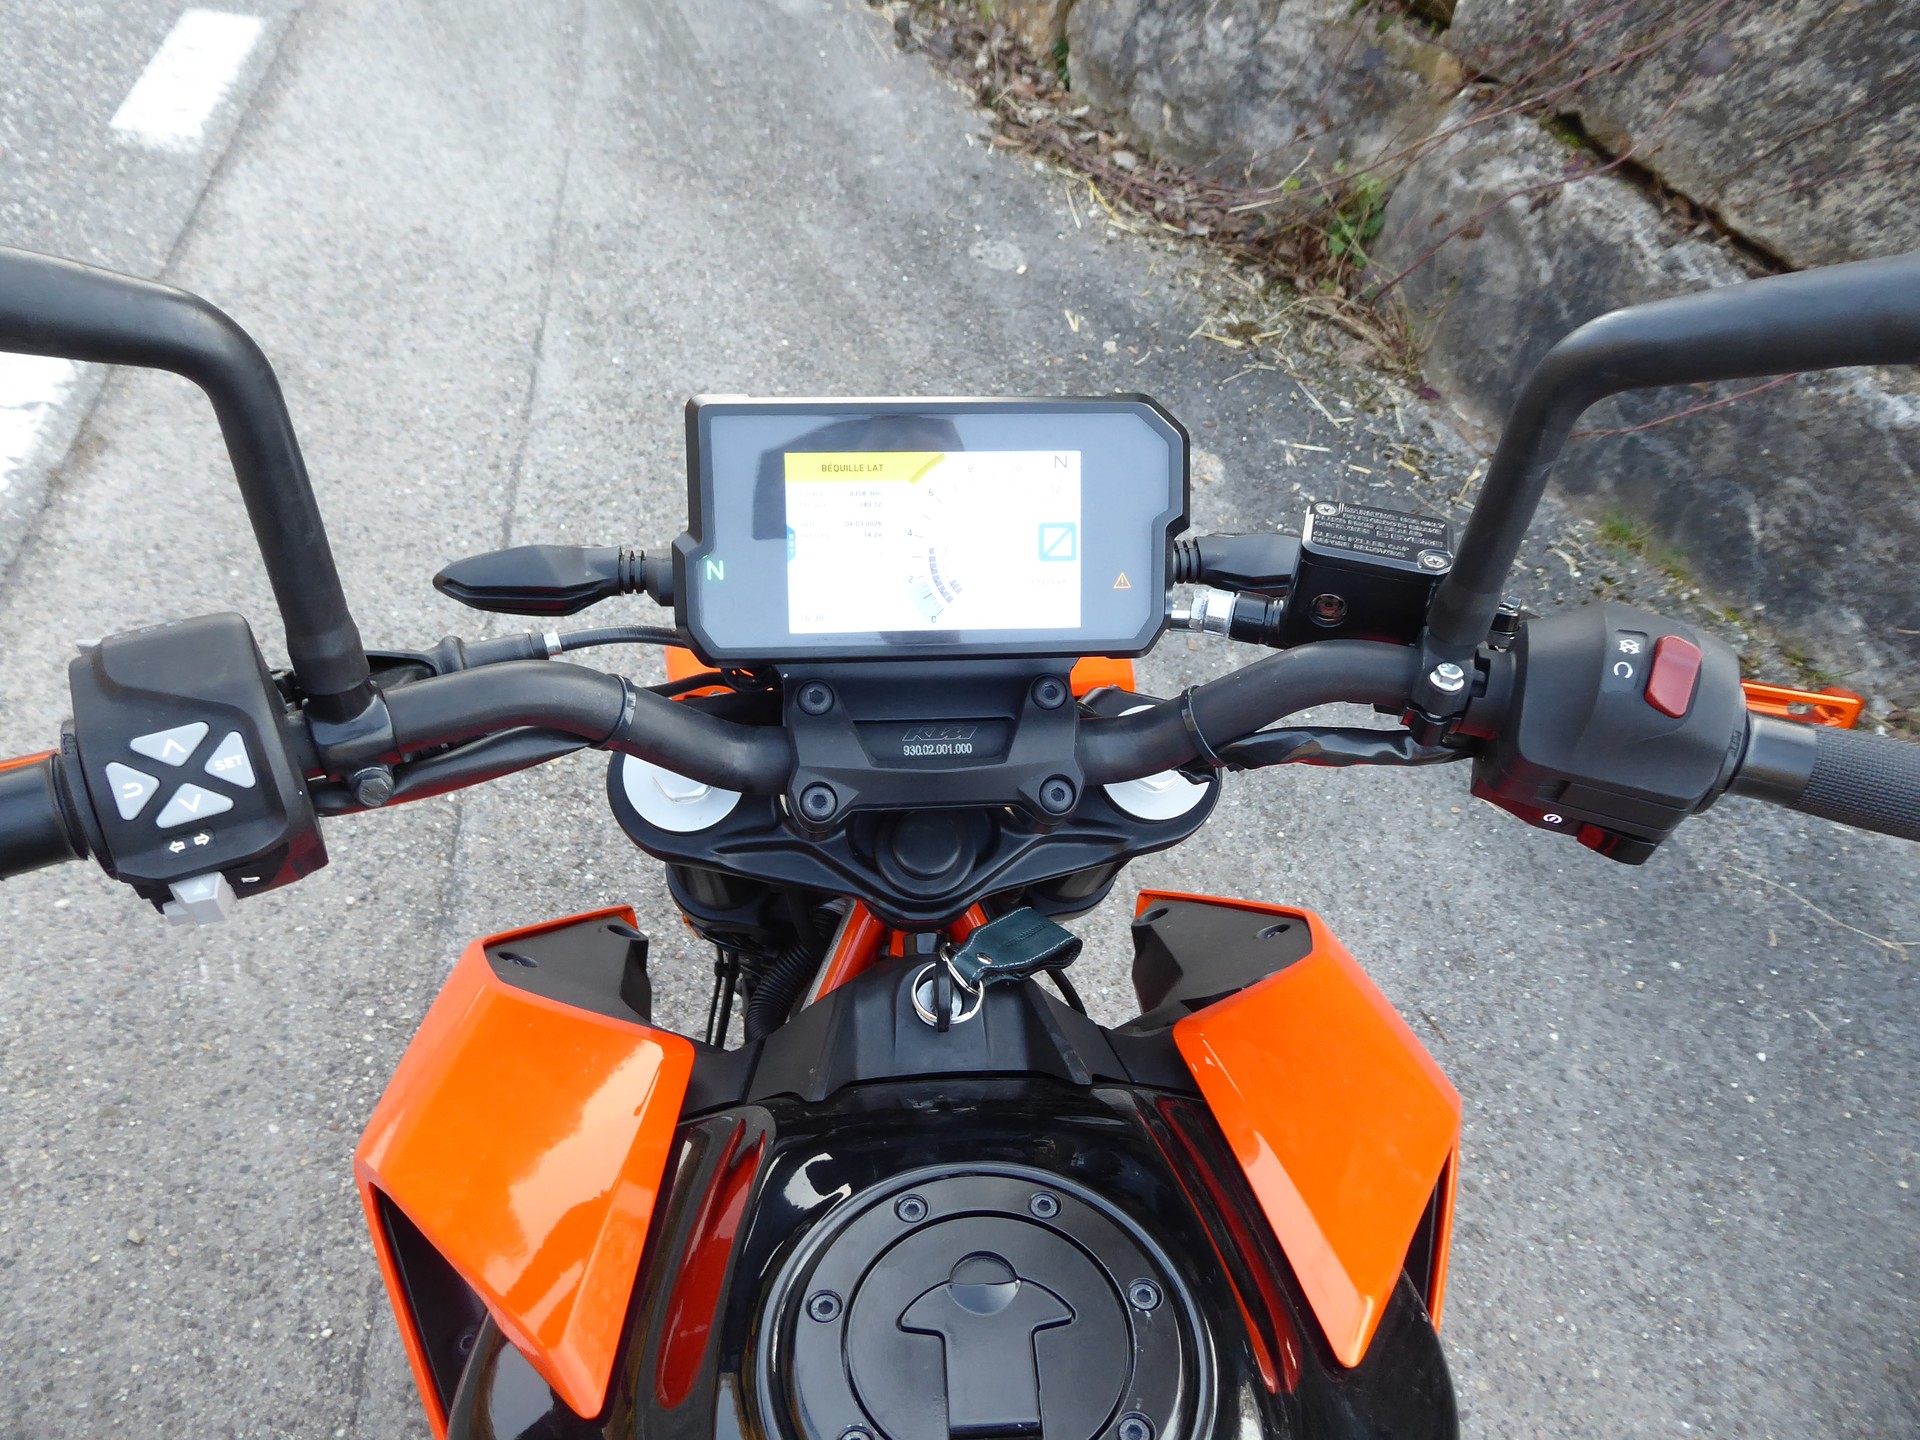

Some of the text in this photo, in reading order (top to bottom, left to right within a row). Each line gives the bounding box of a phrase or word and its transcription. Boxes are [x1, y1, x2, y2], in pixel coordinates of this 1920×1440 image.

[821, 461, 883, 473] BÉQUILLE LAT
[1054, 455, 1068, 468] N
[928, 489, 935, 497] 6
[907, 529, 913, 537] 4
[706, 559, 724, 580] N
[907, 575, 914, 583] 2
[902, 726, 978, 742] KTM
[903, 743, 973, 756] 930.02.001.000
[214, 754, 243, 771] SET
